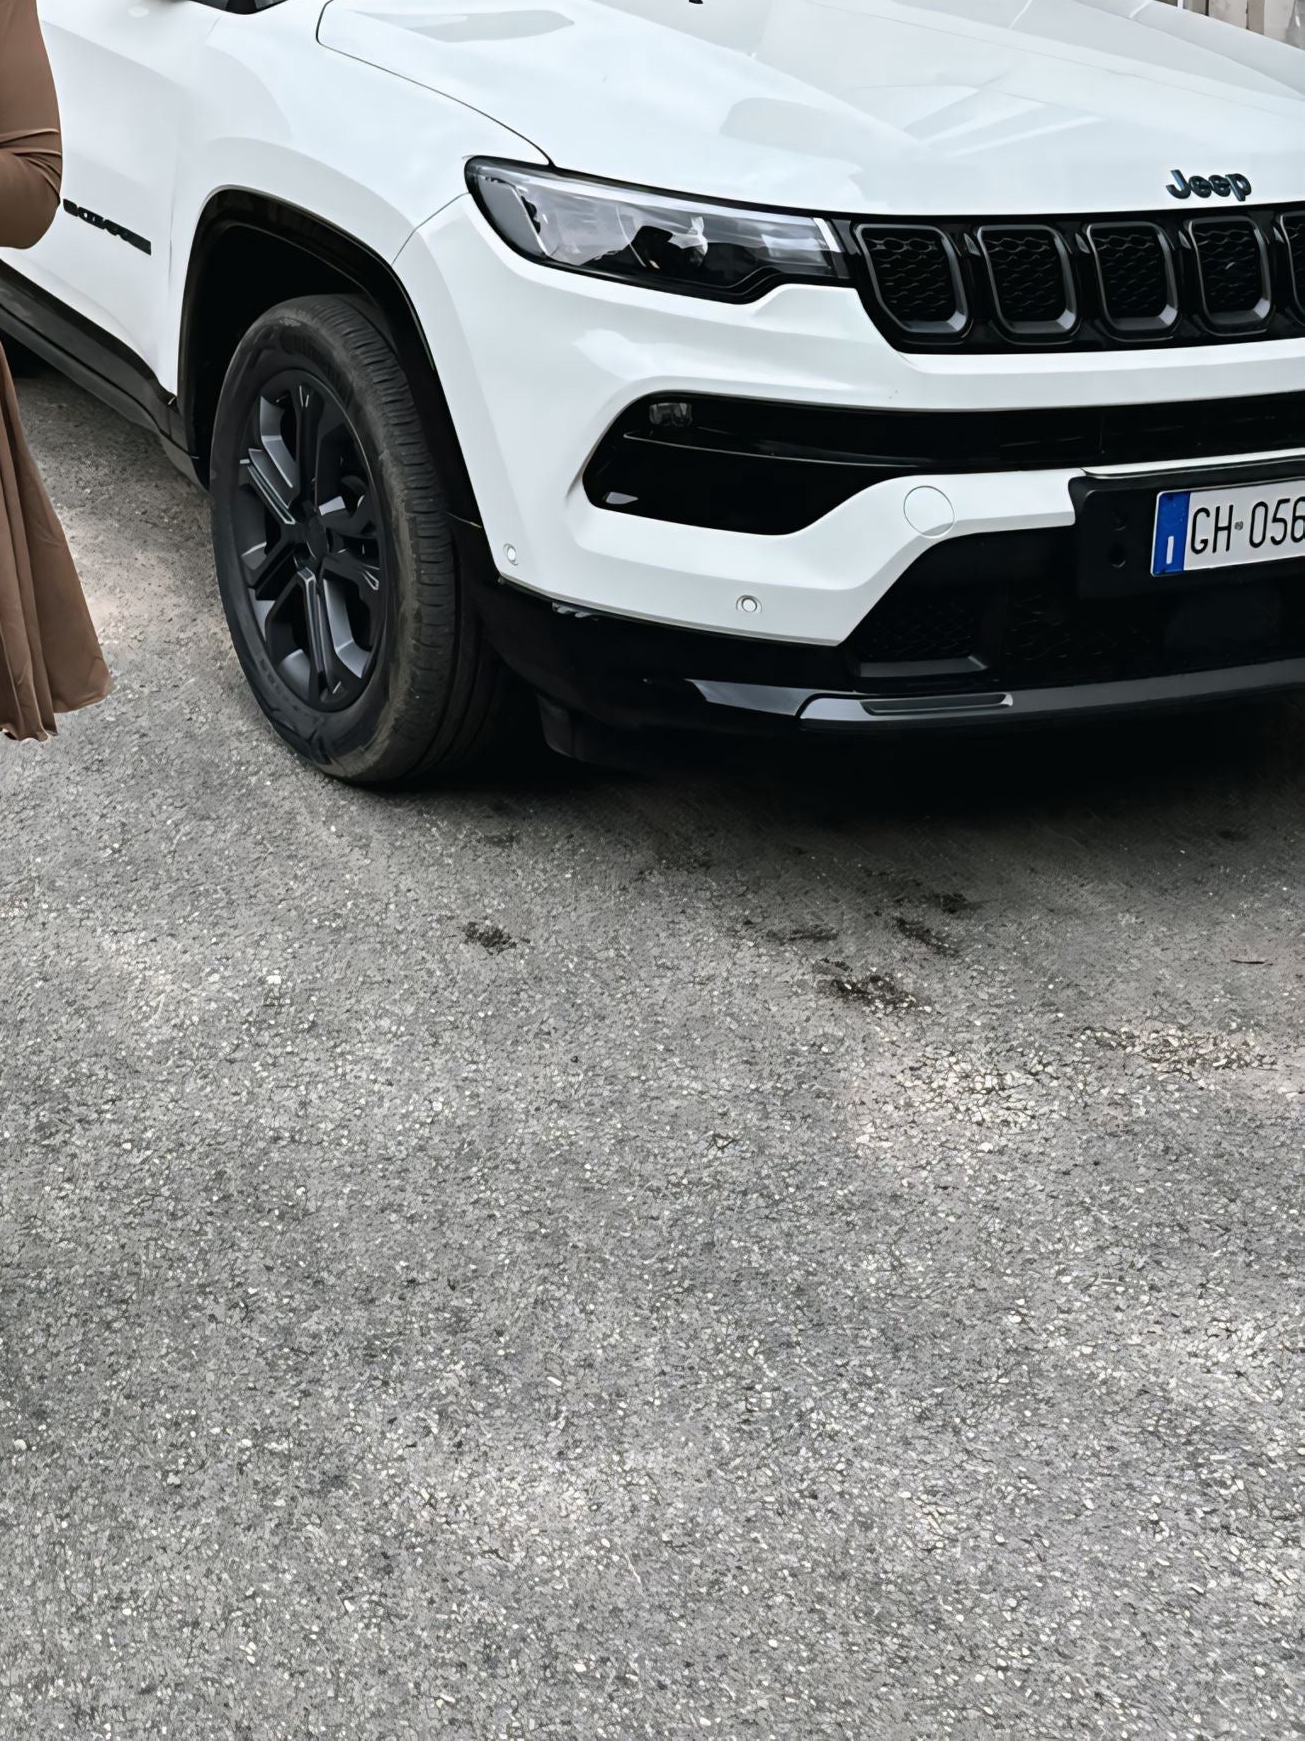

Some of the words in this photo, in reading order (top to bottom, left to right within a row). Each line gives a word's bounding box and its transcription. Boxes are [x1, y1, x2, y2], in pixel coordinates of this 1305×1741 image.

[1166, 169, 1252, 202] Jeep
[1191, 504, 1234, 555] GH
[1249, 496, 1305, 548] 056
